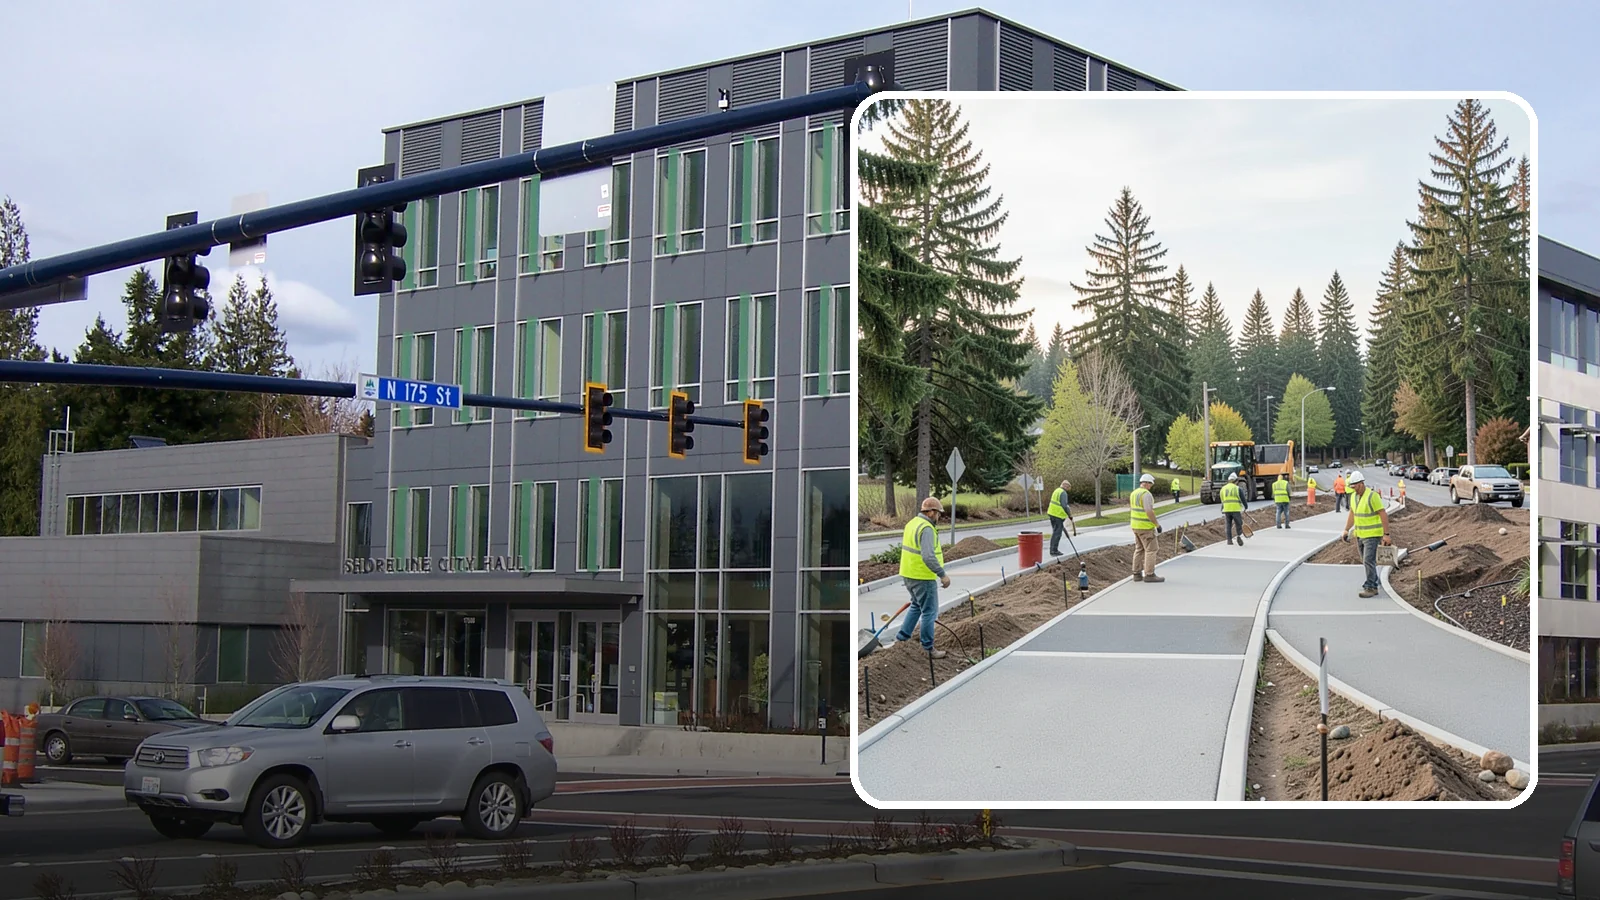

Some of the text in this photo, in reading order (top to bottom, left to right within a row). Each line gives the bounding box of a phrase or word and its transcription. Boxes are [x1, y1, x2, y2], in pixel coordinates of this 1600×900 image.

[387, 380, 451, 406] N 175 St
[344, 555, 525, 574] SHORELINE CITY HALL
